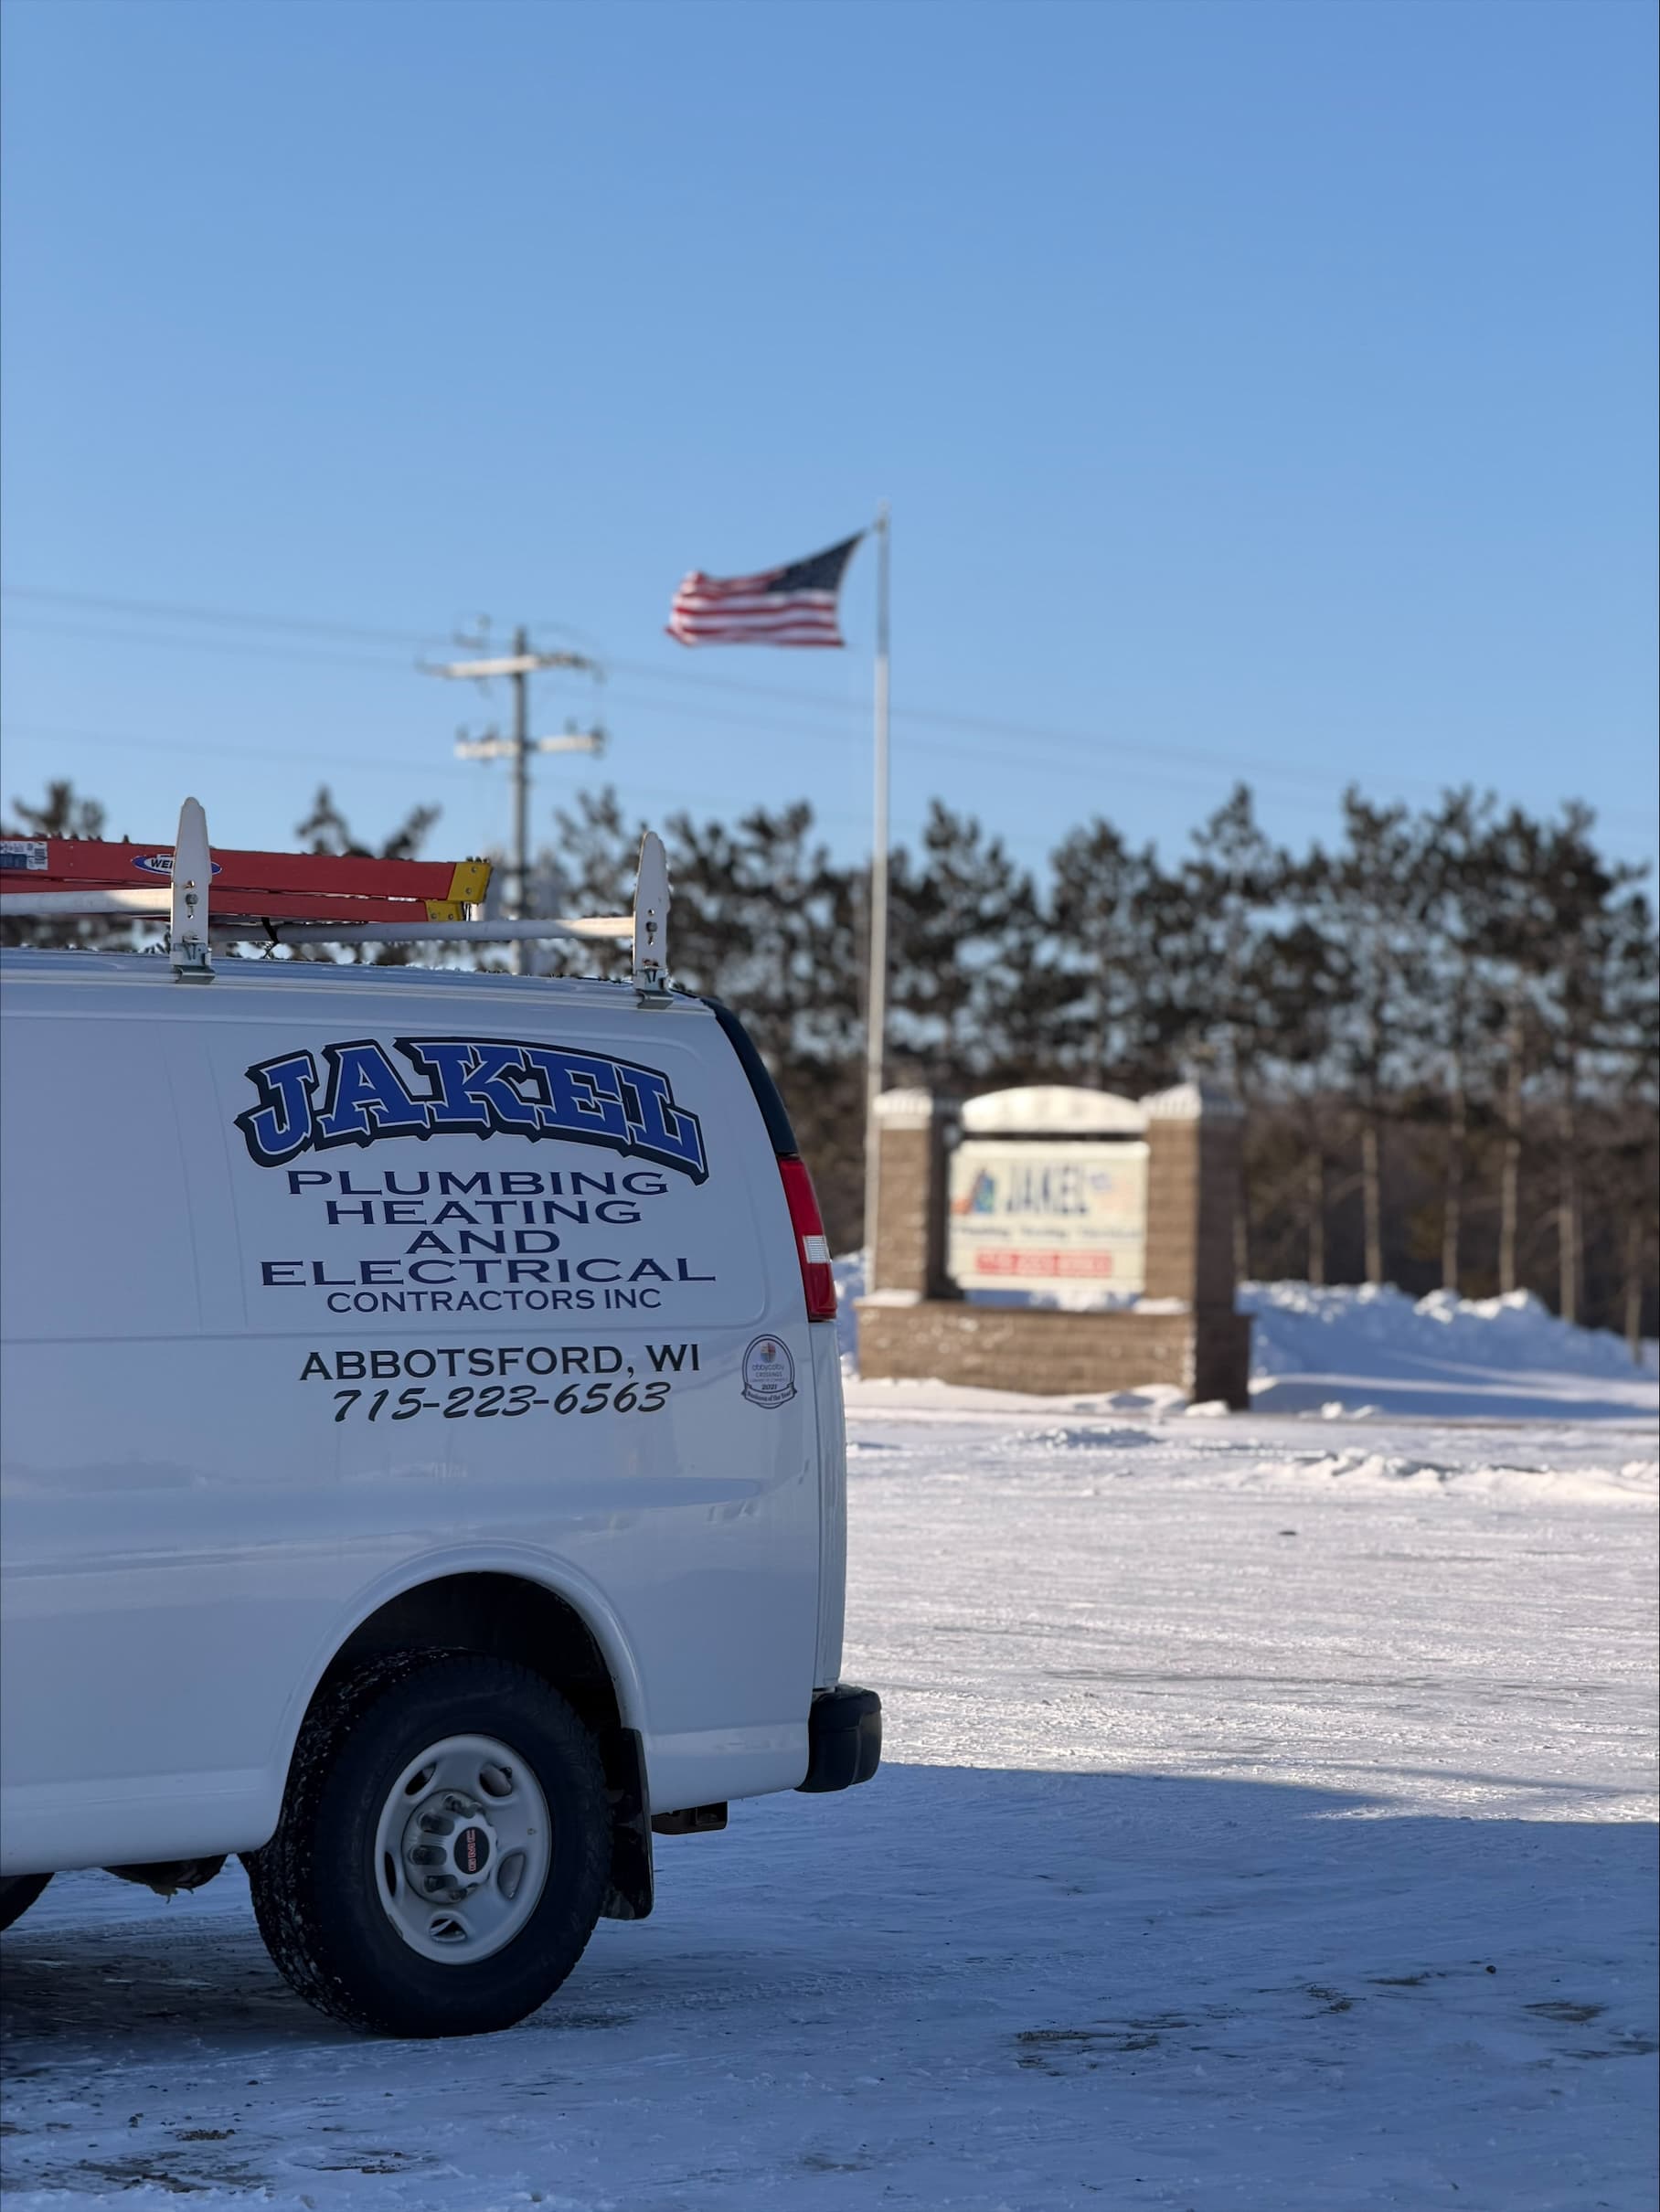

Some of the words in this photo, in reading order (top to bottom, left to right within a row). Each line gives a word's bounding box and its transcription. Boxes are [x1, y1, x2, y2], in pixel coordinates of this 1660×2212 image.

[233, 1037, 709, 1186] JAKEL
[287, 1170, 668, 1196] PLUMBING
[325, 1200, 642, 1225] HEATING
[405, 1230, 559, 1254] AND
[261, 1258, 716, 1286] ELECTRICAL
[326, 1289, 595, 1313] CONTRACTORS
[604, 1288, 662, 1309] INC
[299, 1345, 635, 1378] ABBOTSFORD,
[645, 1344, 700, 1373] WI
[334, 1381, 672, 1422] 715-223-6563
